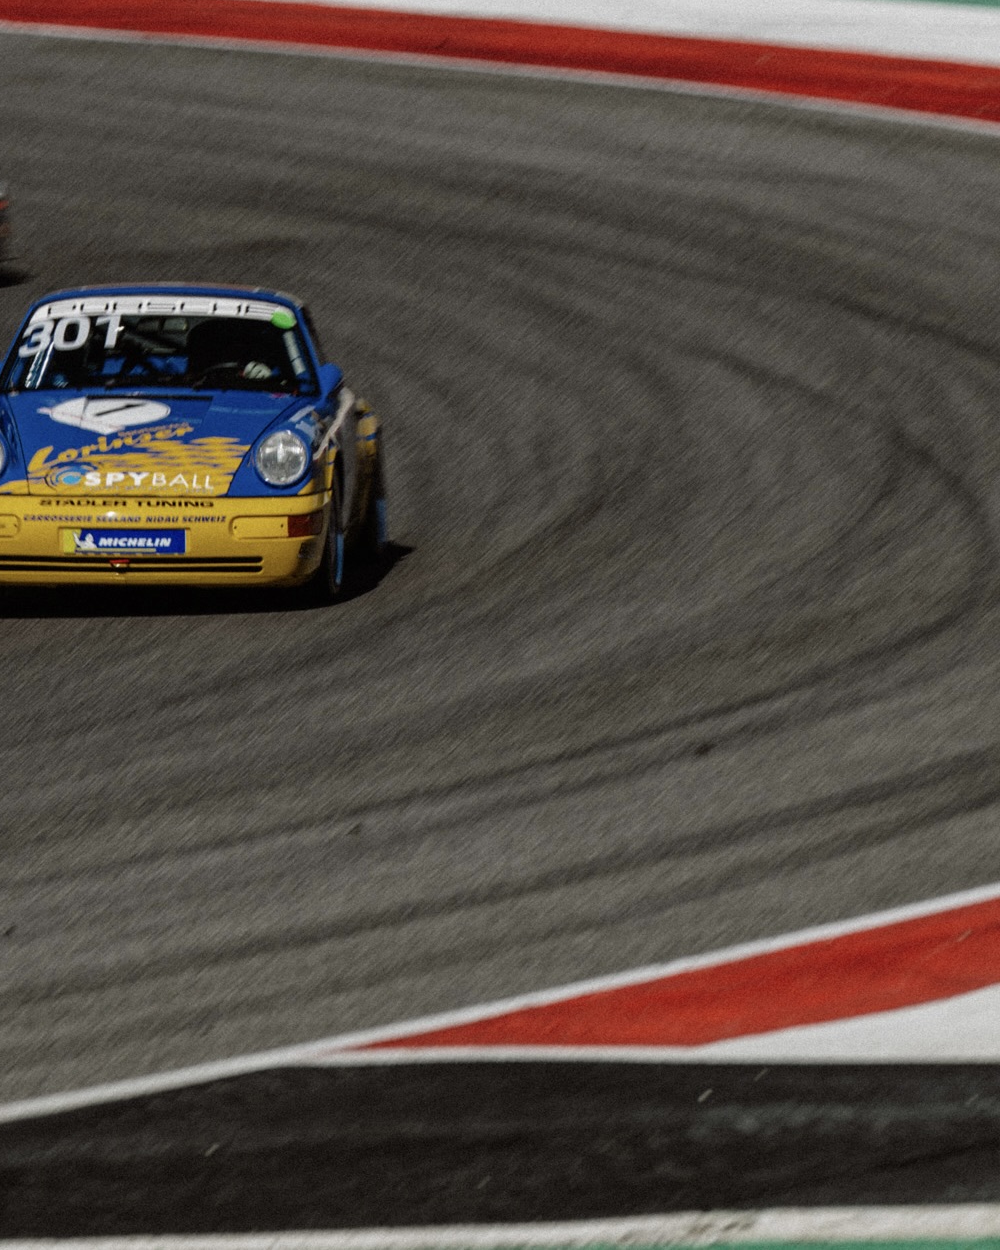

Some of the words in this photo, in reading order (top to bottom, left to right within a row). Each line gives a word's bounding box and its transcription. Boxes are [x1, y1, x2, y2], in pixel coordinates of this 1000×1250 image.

[18, 315, 124, 358] 301
[84, 471, 214, 490] SPYBALL
[135, 499, 214, 508] TUNING
[98, 536, 172, 548] MICHELIN
